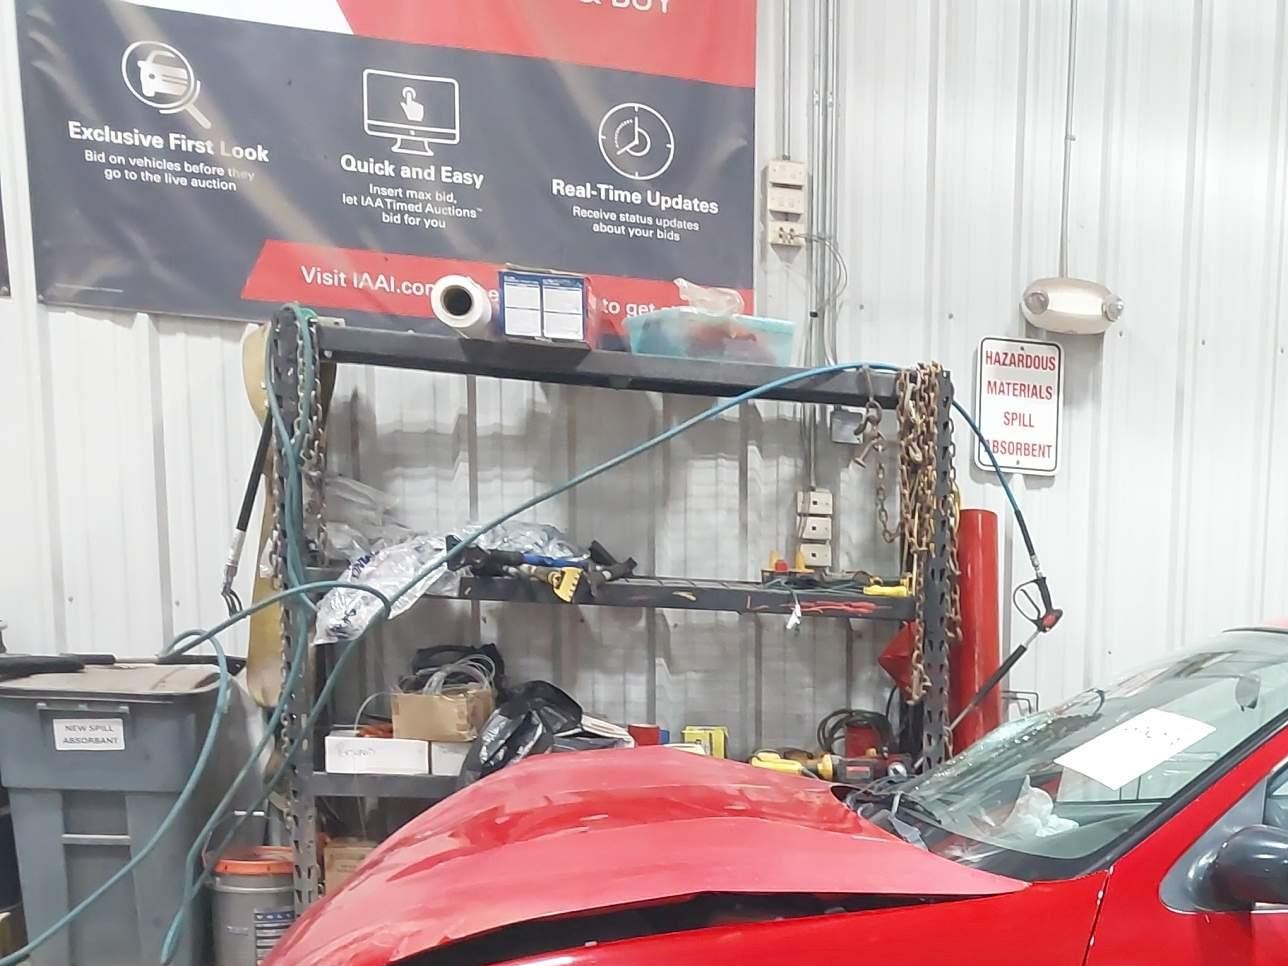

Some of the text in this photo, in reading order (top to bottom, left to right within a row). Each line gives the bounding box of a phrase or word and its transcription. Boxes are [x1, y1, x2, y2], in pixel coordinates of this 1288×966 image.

[68, 121, 270, 162] Exclusive First Look
[85, 150, 255, 181] Bid on vehicles before they
[341, 154, 484, 190] Quick and Easy
[104, 168, 237, 191] go to the live auction
[342, 193, 358, 205] let
[370, 184, 457, 205] Insert max bid,
[552, 179, 719, 214] Real-Time Updates
[382, 212, 446, 229] bid for you
[573, 206, 700, 231] Receive status updates
[593, 223, 681, 241] about your bids
[301, 265, 346, 288] Visit
[985, 350, 1056, 371] HAZARDOUS
[987, 380, 1053, 400] MATERIALS
[1003, 411, 1034, 428] SPILL
